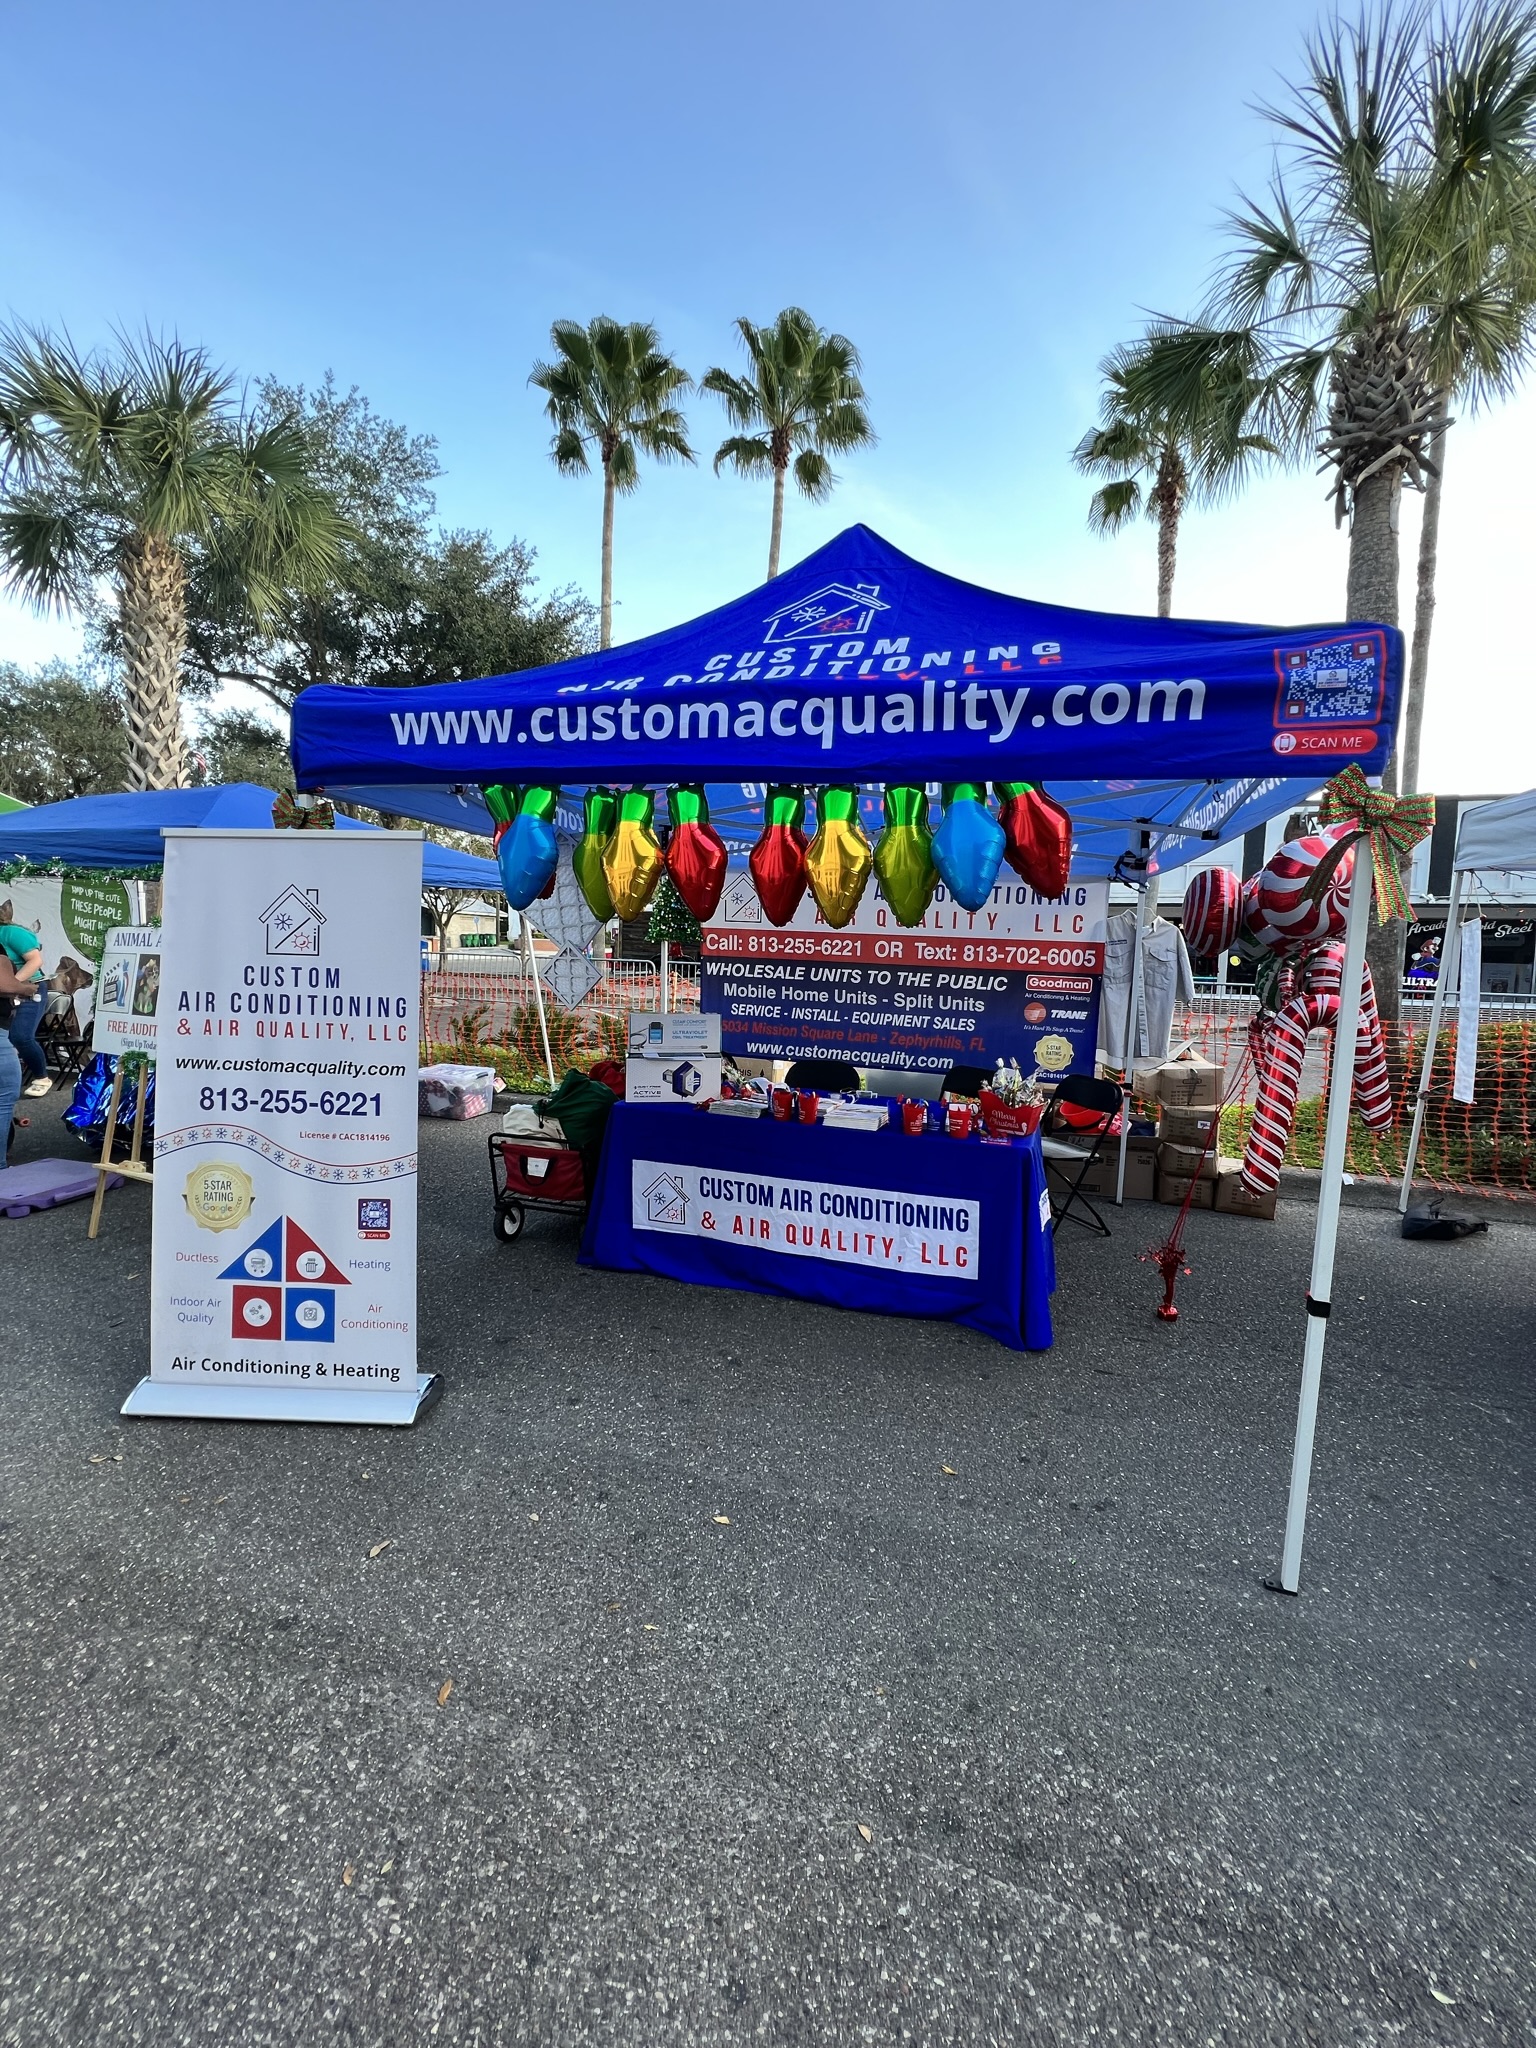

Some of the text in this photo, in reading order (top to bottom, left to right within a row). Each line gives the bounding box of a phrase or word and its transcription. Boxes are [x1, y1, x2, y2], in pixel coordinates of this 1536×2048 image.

[705, 637, 910, 671] CUSTOM
[390, 679, 1207, 749] www.customacquality.com
[1301, 736, 1363, 749] SCAN ME
[94, 890, 104, 900] THE
[71, 899, 122, 920] THESE PEOPLE
[74, 916, 97, 931] MIGHT
[876, 909, 1011, 933] QALITY,
[1034, 913, 1085, 934] LLC
[1494, 922, 1533, 938] Steel
[80, 933, 98, 947] TREA
[113, 932, 152, 947] ANIMAL
[706, 933, 1096, 967] Call: 813-255-6221 OR Text: 813-702-6005
[243, 965, 340, 989] CUSTOM
[706, 962, 1008, 992] WHOLESALE UNITS TO THE PUBLIC
[1029, 977, 1089, 990] Goodman
[178, 991, 407, 1019] AIR CONDITIONING
[723, 982, 776, 1000] Mobile
[781, 986, 829, 1002] Home
[835, 989, 878, 1006] Units
[893, 992, 933, 1011] Split
[939, 995, 985, 1012] Units
[1033, 993, 1064, 1001] Conditioning
[730, 1003, 781, 1018] SERVICE
[791, 1007, 841, 1023] INSTALL
[852, 1011, 930, 1029] EQUIPMENT
[932, 1017, 976, 1032] SALES
[1051, 1009, 1088, 1020] TRANE
[107, 1020, 158, 1037] FREE AUDIT
[177, 1018, 407, 1042] & AIR QUALITY, LLC
[722, 1019, 748, 1034] 5034
[751, 1022, 798, 1037] Mission
[800, 1025, 844, 1043] Square
[847, 1029, 878, 1044] Lane
[889, 1031, 965, 1051] Zephyrhills,
[969, 1037, 986, 1051] FL
[135, 1039, 142, 1050] Up
[143, 1039, 157, 1050] Toda
[746, 1042, 954, 1070] www.customacquality.com
[175, 1056, 406, 1078] www.customacquality.com
[200, 1086, 381, 1117] 813-255-6221
[300, 1131, 330, 1140] License
[338, 1132, 390, 1142] CAC1814196
[203, 1180, 232, 1191] 5-STAR
[203, 1191, 234, 1202] RATING
[699, 1175, 970, 1233] CUSTOM AIR CONDITIONING
[202, 1203, 233, 1214] Google
[701, 1211, 968, 1268] & AIR QUALITY, LLC
[175, 1252, 219, 1264] Ductless
[349, 1259, 391, 1272] Heating
[169, 1296, 222, 1308] Indoor Air
[367, 1304, 383, 1314] Air
[177, 1312, 214, 1325] Quality
[340, 1319, 409, 1332] Conditioning
[171, 1357, 401, 1382] Air Conditioning & Heating
